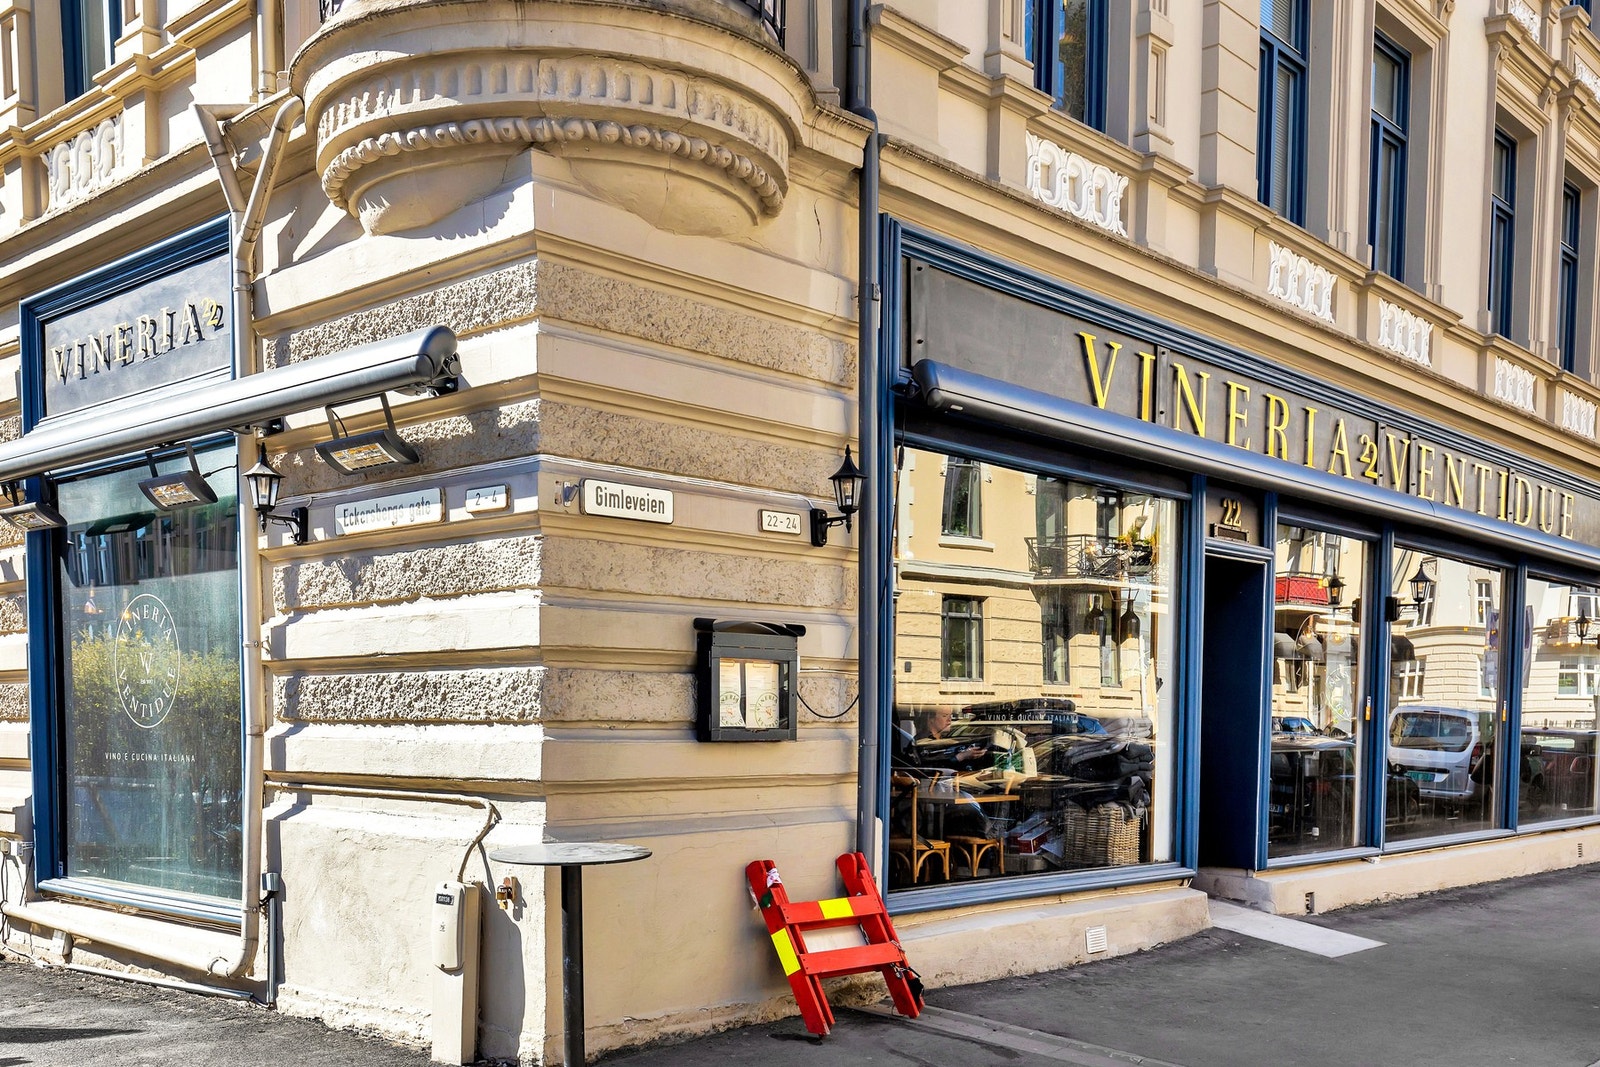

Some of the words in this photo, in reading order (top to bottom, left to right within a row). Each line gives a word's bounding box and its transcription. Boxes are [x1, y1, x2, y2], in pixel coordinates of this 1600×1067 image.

[51, 298, 199, 382] VINERIA
[1079, 331, 1355, 479] VINERIA
[1385, 432, 1575, 541] VENTIDUE
[343, 503, 404, 526] Eckersbergs
[409, 496, 431, 522] gate
[594, 485, 665, 515] Gimleveien
[1223, 497, 1242, 527] 22
[120, 603, 172, 642] VINERIA
[119, 667, 176, 718] VENTIDUE
[987, 713, 1007, 721] VINO
[1017, 712, 1046, 721] CUCIN
[104, 752, 122, 761] VINO
[131, 752, 158, 762] CUCINA
[160, 753, 196, 763] ITALIANA
